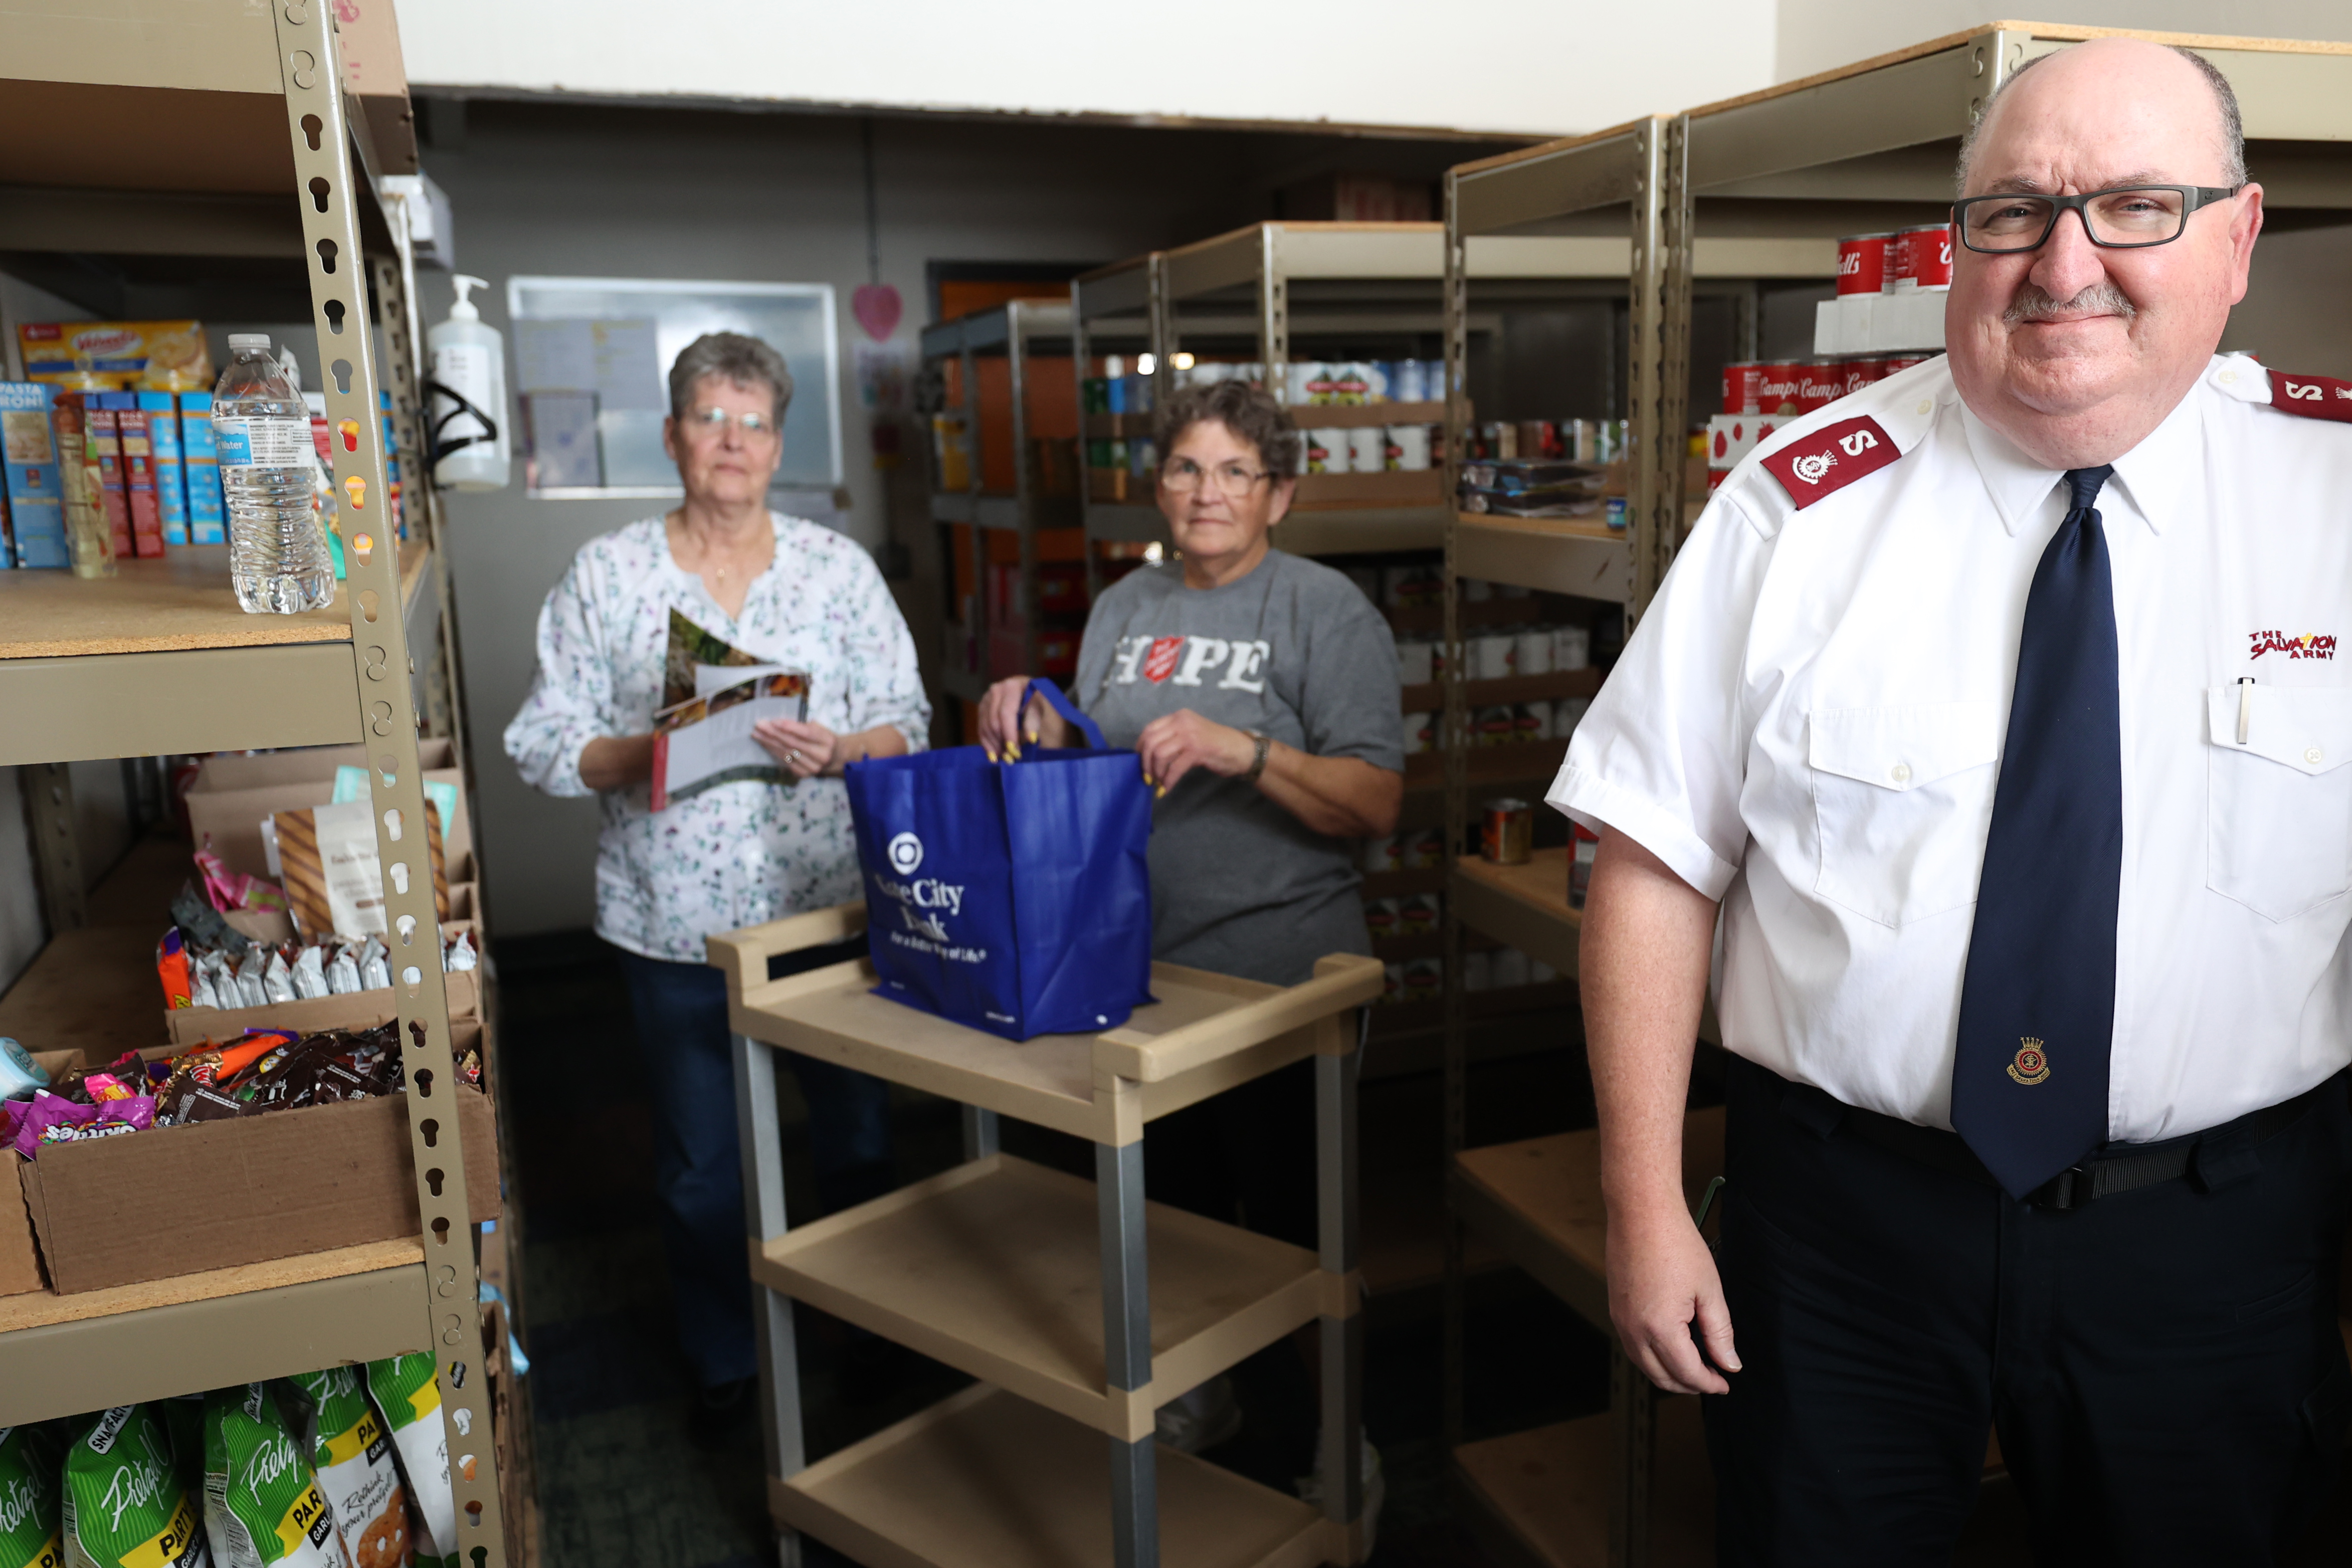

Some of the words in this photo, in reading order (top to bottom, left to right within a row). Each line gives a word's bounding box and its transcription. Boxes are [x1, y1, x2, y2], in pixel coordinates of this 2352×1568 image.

[2285, 381, 2323, 400] S
[221, 441, 243, 449] Water
[1838, 430, 1879, 456] S
[2249, 630, 2282, 641] THE
[2250, 632, 2337, 660] SALVATION
[2290, 649, 2334, 660] ARMY
[912, 878, 965, 916] City
